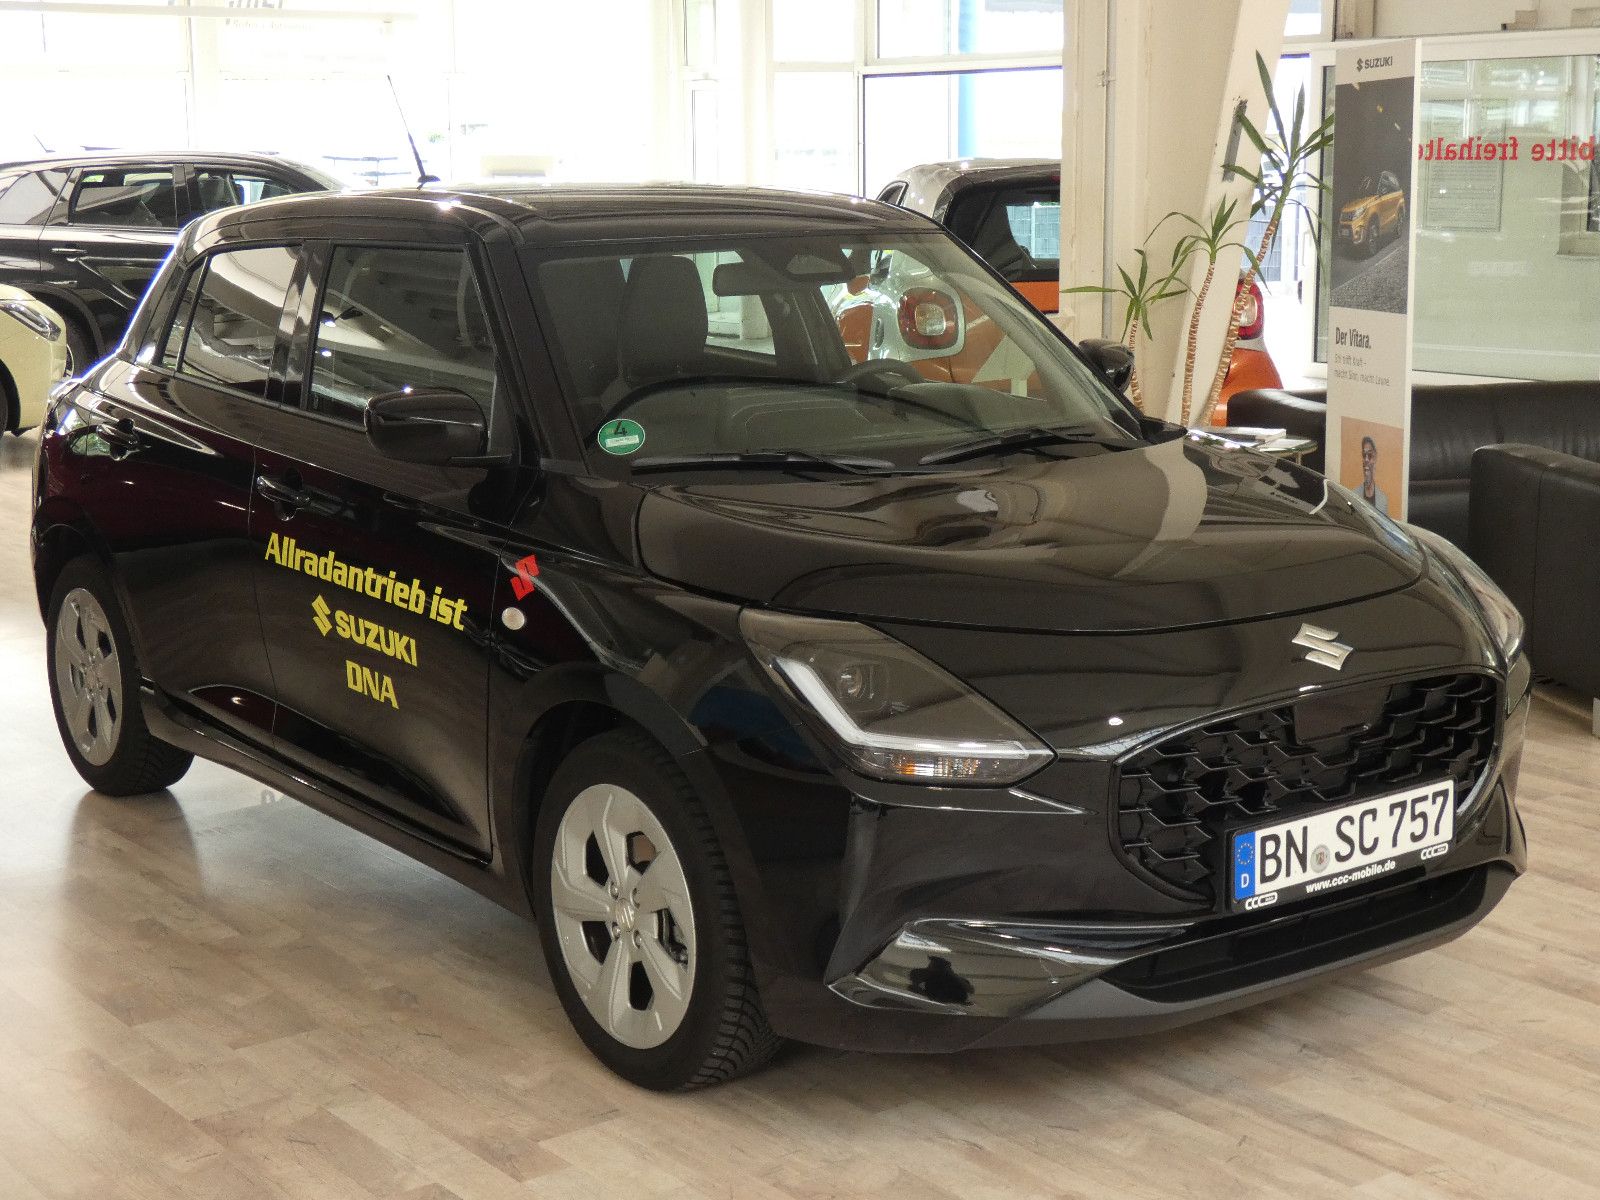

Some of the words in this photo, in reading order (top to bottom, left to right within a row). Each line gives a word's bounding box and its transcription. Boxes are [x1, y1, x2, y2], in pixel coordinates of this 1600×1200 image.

[1364, 55, 1393, 70] SUZUKI
[1335, 327, 1348, 345] Der
[1349, 328, 1371, 349] Vitara.
[614, 421, 627, 435] 4
[264, 531, 427, 616] Allradantrieb
[429, 586, 468, 632] ist
[334, 609, 418, 667] SUZUKI
[345, 659, 400, 710] DNA
[1259, 825, 1308, 884] BN
[1334, 808, 1380, 863] SC
[1388, 788, 1450, 848] 757
[1241, 873, 1250, 889] D
[1305, 860, 1396, 893] www.ccc-mobile.de
